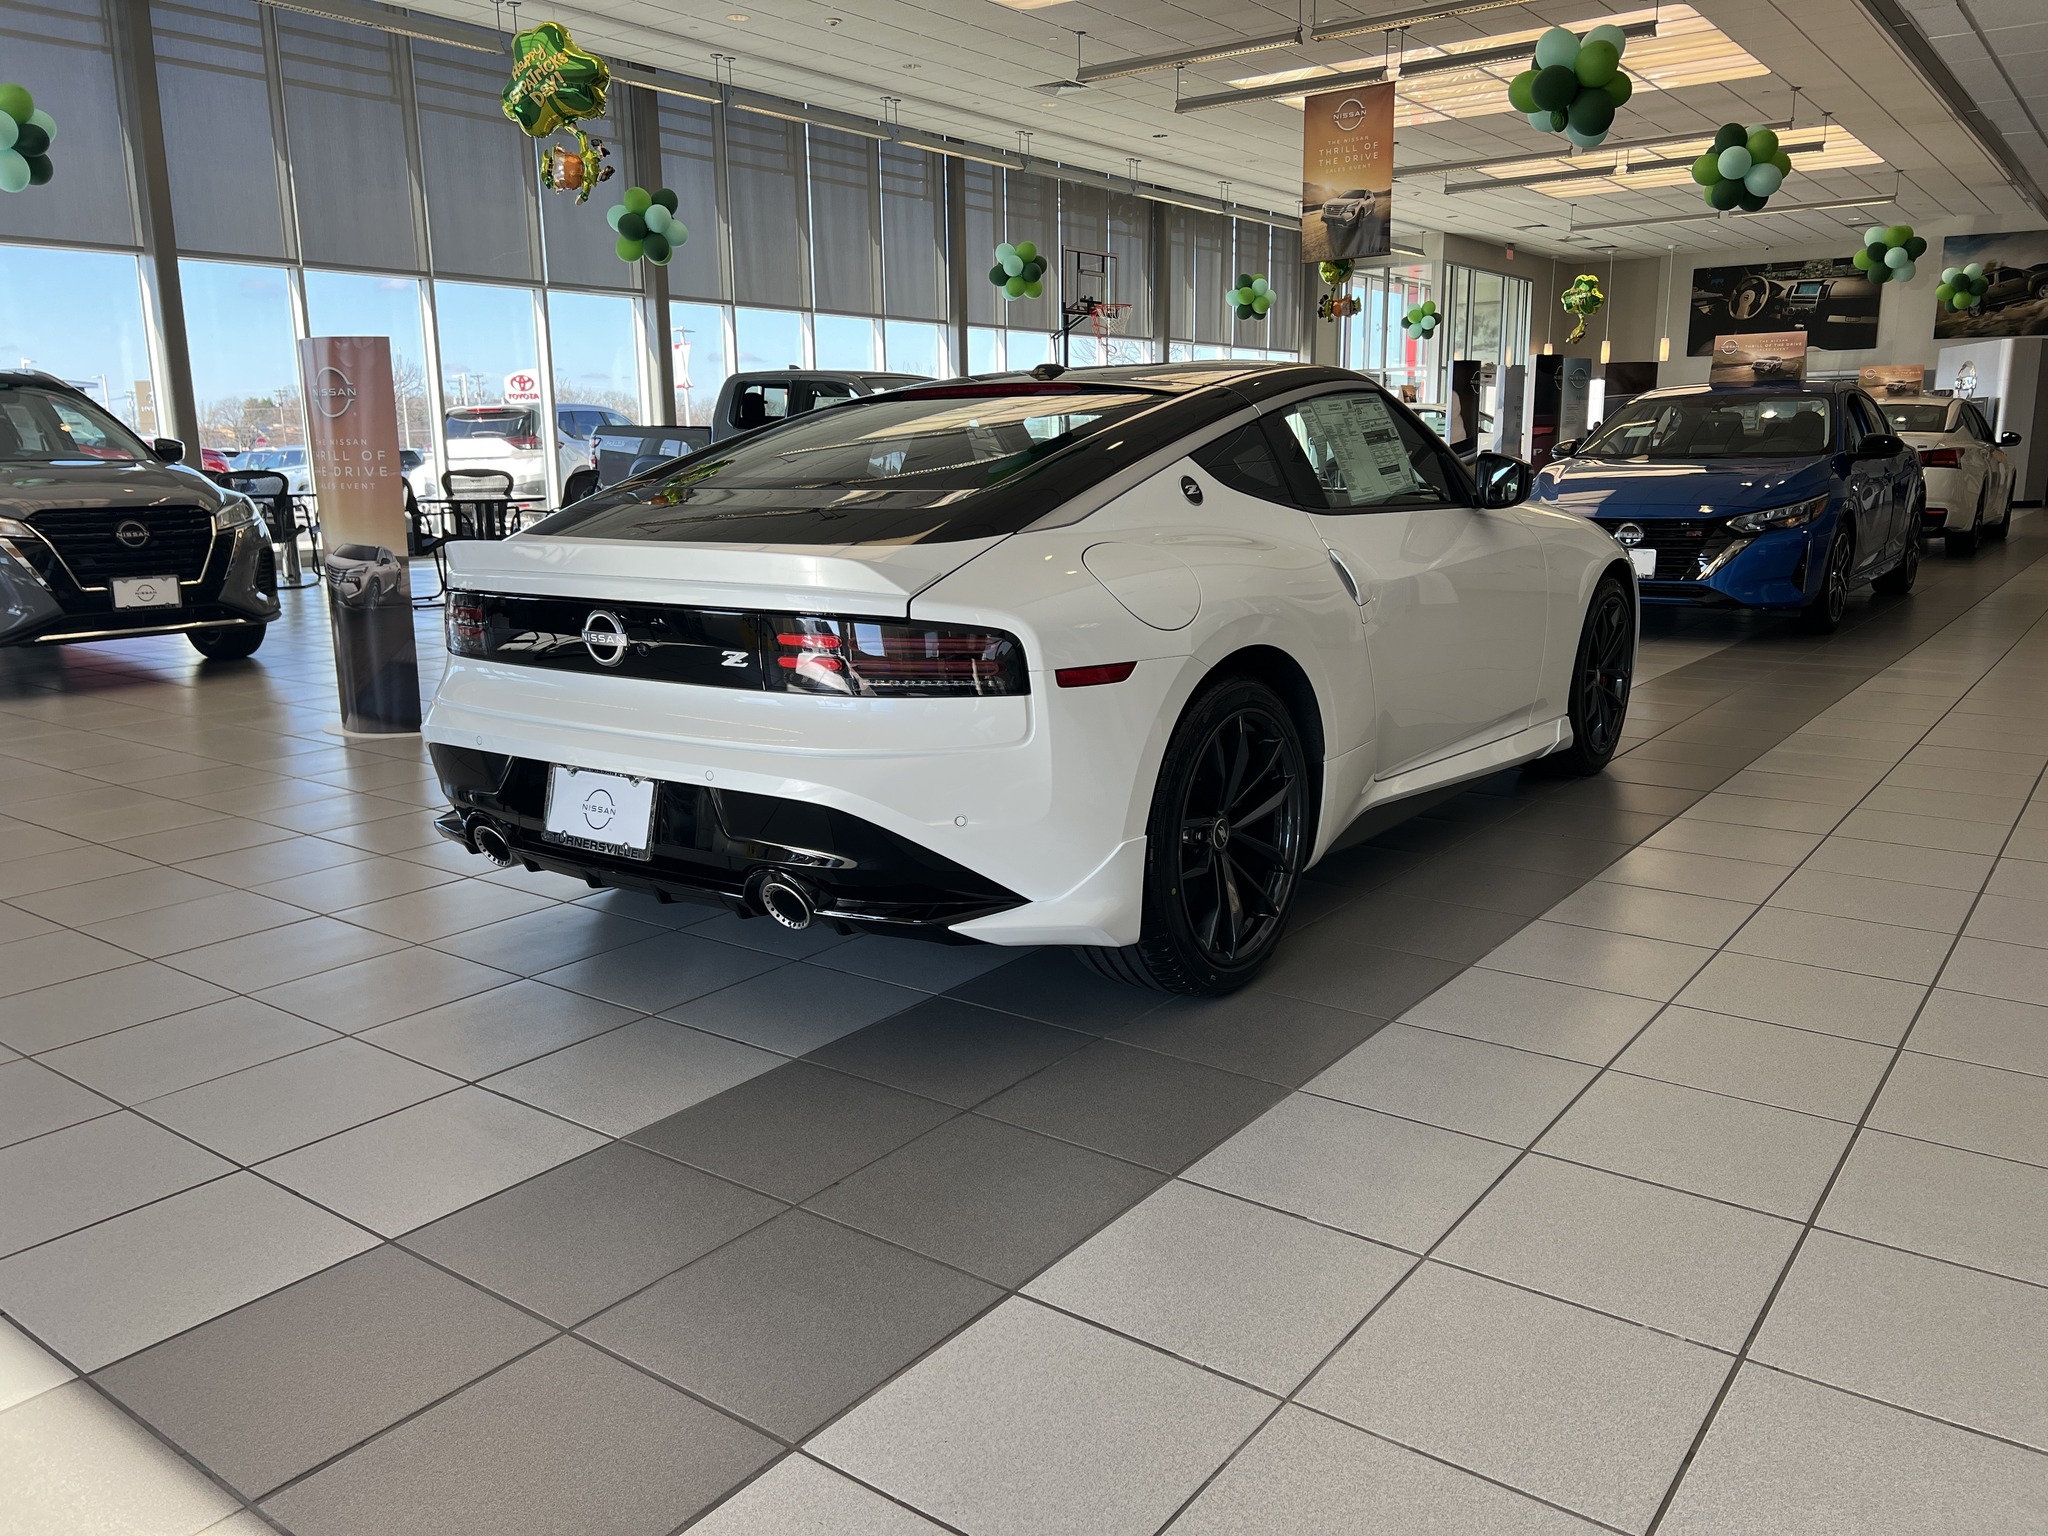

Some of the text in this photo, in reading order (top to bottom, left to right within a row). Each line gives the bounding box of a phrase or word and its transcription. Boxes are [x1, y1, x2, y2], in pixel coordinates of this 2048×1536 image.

[1333, 109, 1367, 120] NISSAN
[1344, 135, 1369, 143] NISSAN
[1319, 141, 1379, 156] THRILL OF
[1318, 152, 1379, 167] THE DRIVE
[1325, 163, 1371, 174] SALES EVENT
[312, 387, 357, 397] NISSAN
[330, 438, 368, 446] NISSAN
[361, 450, 386, 461] OF
[333, 466, 388, 477] DRIVE
[340, 482, 376, 490] EVENT
[1184, 484, 1200, 495] Z
[582, 631, 626, 646] NISSAN
[721, 650, 749, 668] Z
[582, 803, 617, 816] NISSAN
[552, 832, 639, 858] TURNERSVILLE
